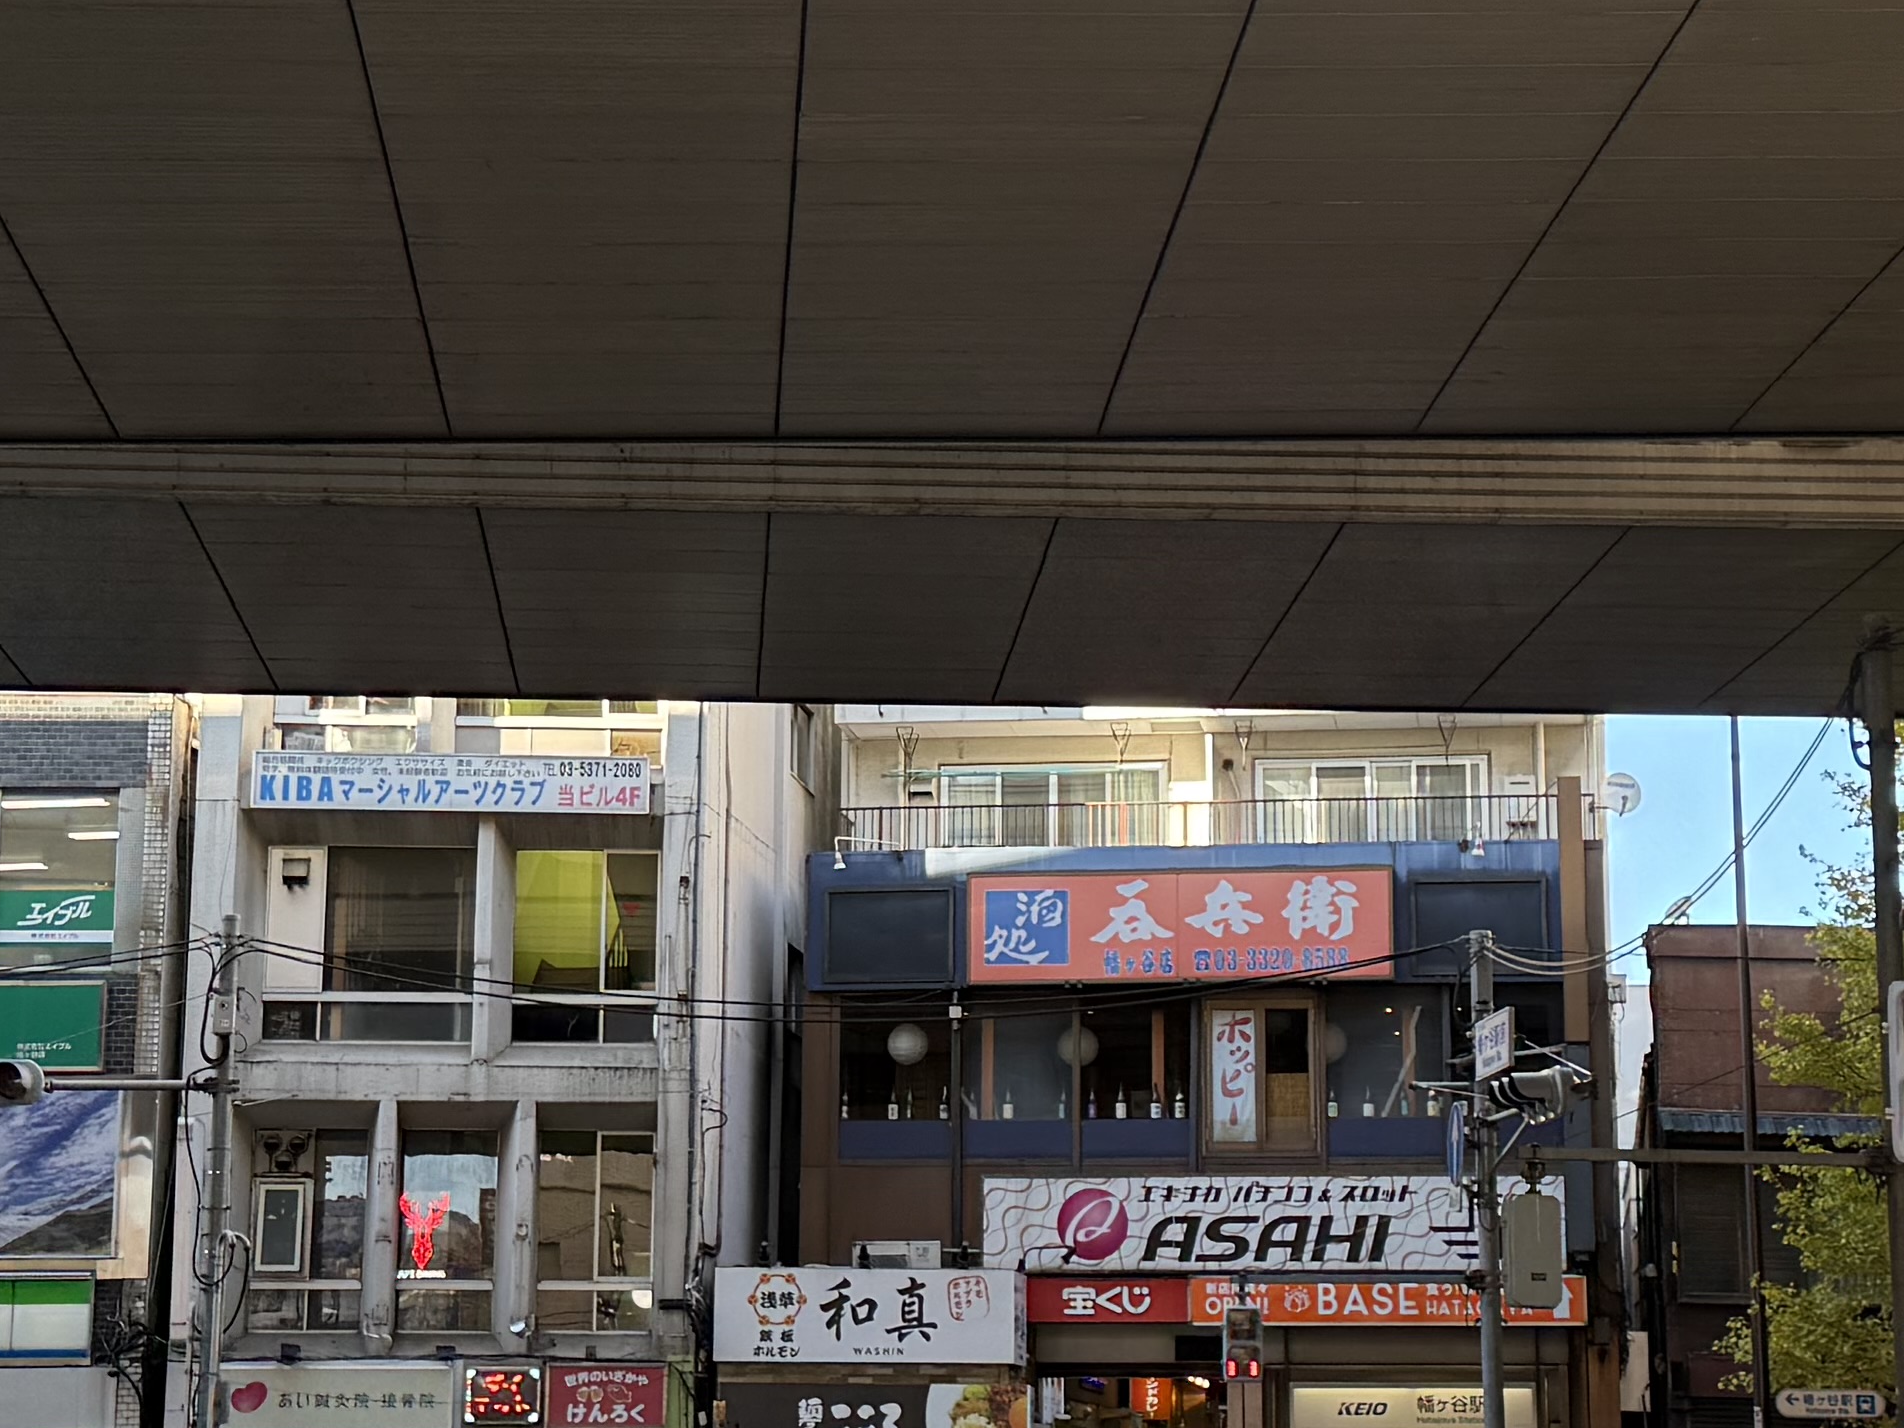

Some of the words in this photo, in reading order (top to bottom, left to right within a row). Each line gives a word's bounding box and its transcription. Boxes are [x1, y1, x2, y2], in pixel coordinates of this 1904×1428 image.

[259, 774, 547, 806] KIBAマーシャルアーツクラブ
[557, 783, 642, 808] 当ビル4F
[16, 894, 96, 926] エイブル
[1089, 875, 1360, 943] 呑兵衛
[1216, 1012, 1256, 1127] ホッピー
[1136, 1184, 1225, 1204] エキチカ
[1141, 1214, 1397, 1263] ASAHI
[819, 1276, 939, 1344] 和真
[1062, 1285, 1152, 1316] 宝くじ
[1317, 1282, 1420, 1316] BASE
[752, 1345, 801, 1358] ホルモン
[852, 1346, 906, 1357] WASHIN
[566, 1403, 646, 1423] けんろく
[1337, 1401, 1388, 1416] KEIO
